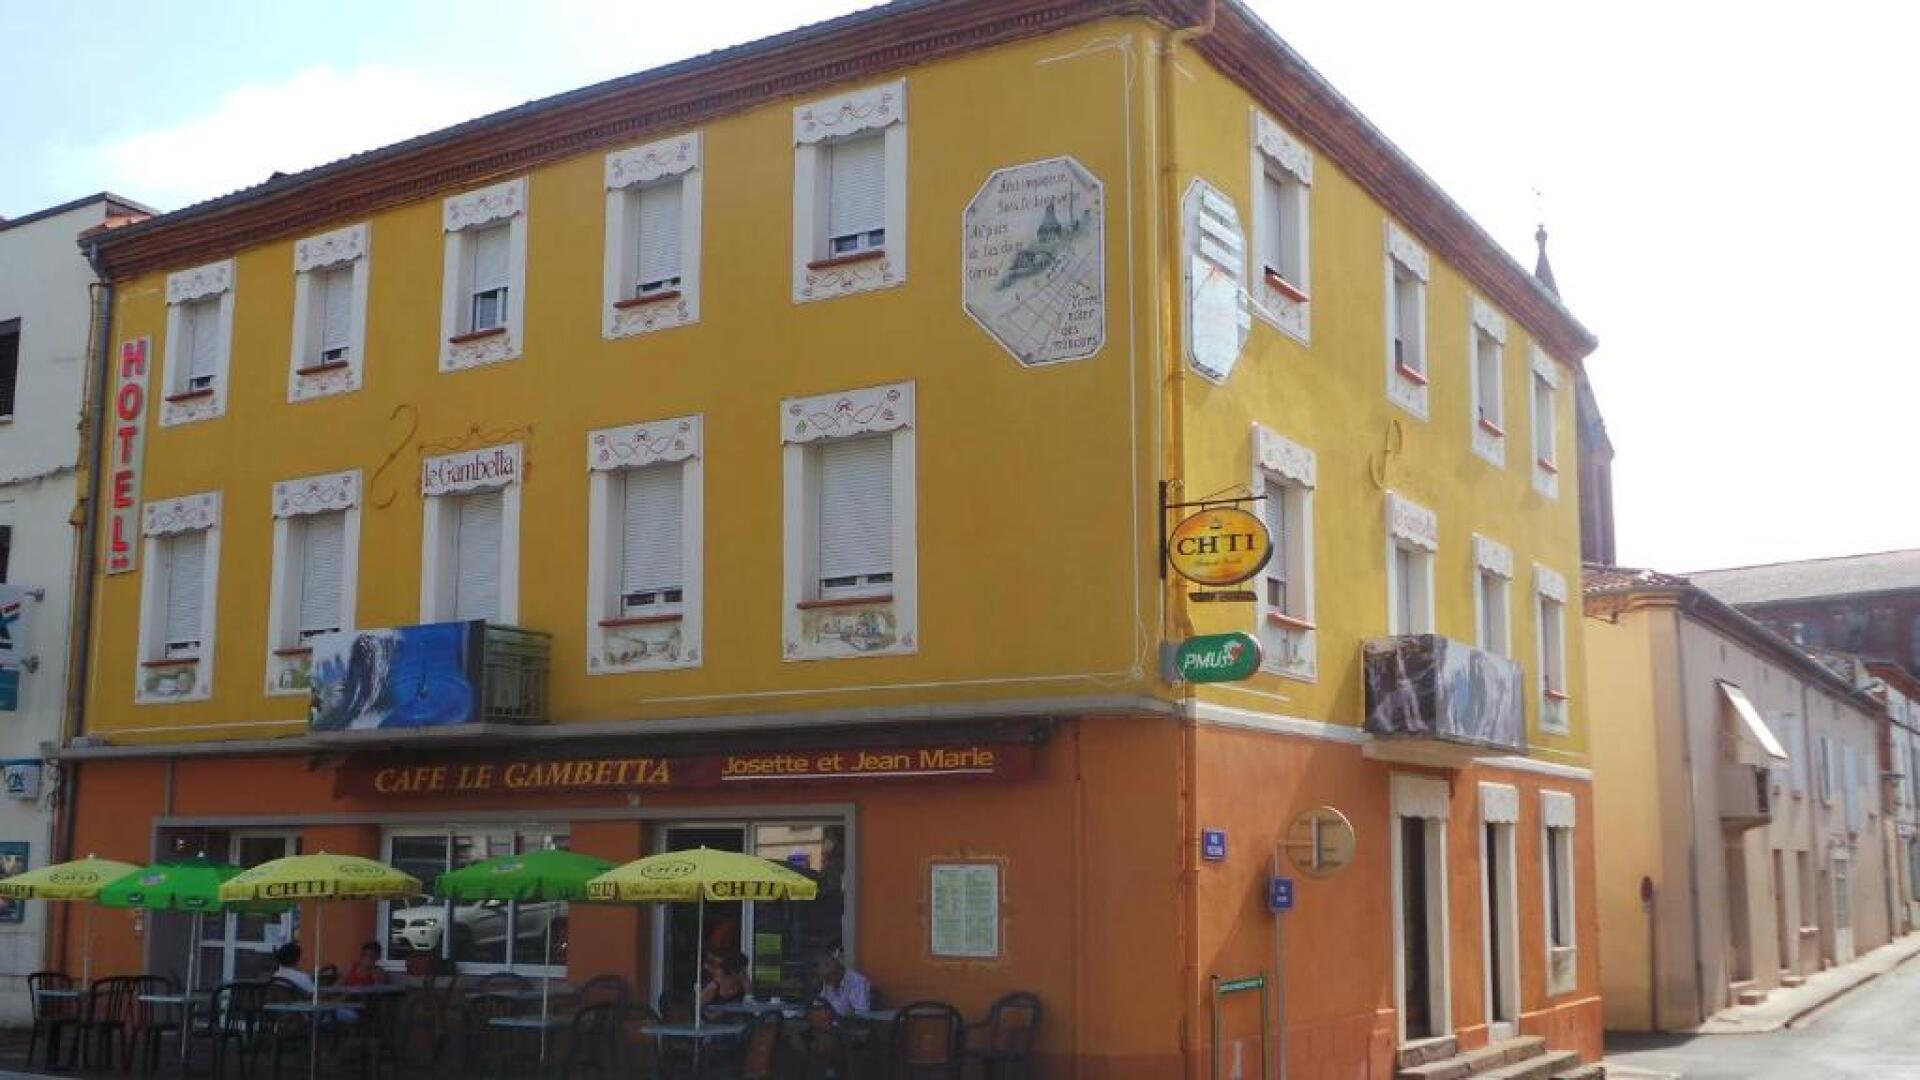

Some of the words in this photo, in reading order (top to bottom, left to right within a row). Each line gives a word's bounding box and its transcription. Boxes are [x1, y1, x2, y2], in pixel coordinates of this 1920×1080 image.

[111, 338, 147, 552] HOTEL
[425, 462, 438, 488] le
[439, 449, 513, 486] Gambetta
[1185, 650, 1222, 669] PMU
[374, 767, 446, 792] CAFE
[458, 766, 492, 789] LE
[504, 757, 671, 788] GAMBETTA
[722, 756, 808, 775] Josette
[817, 753, 842, 771] et
[851, 751, 910, 771] Jean
[919, 747, 994, 769] Marie
